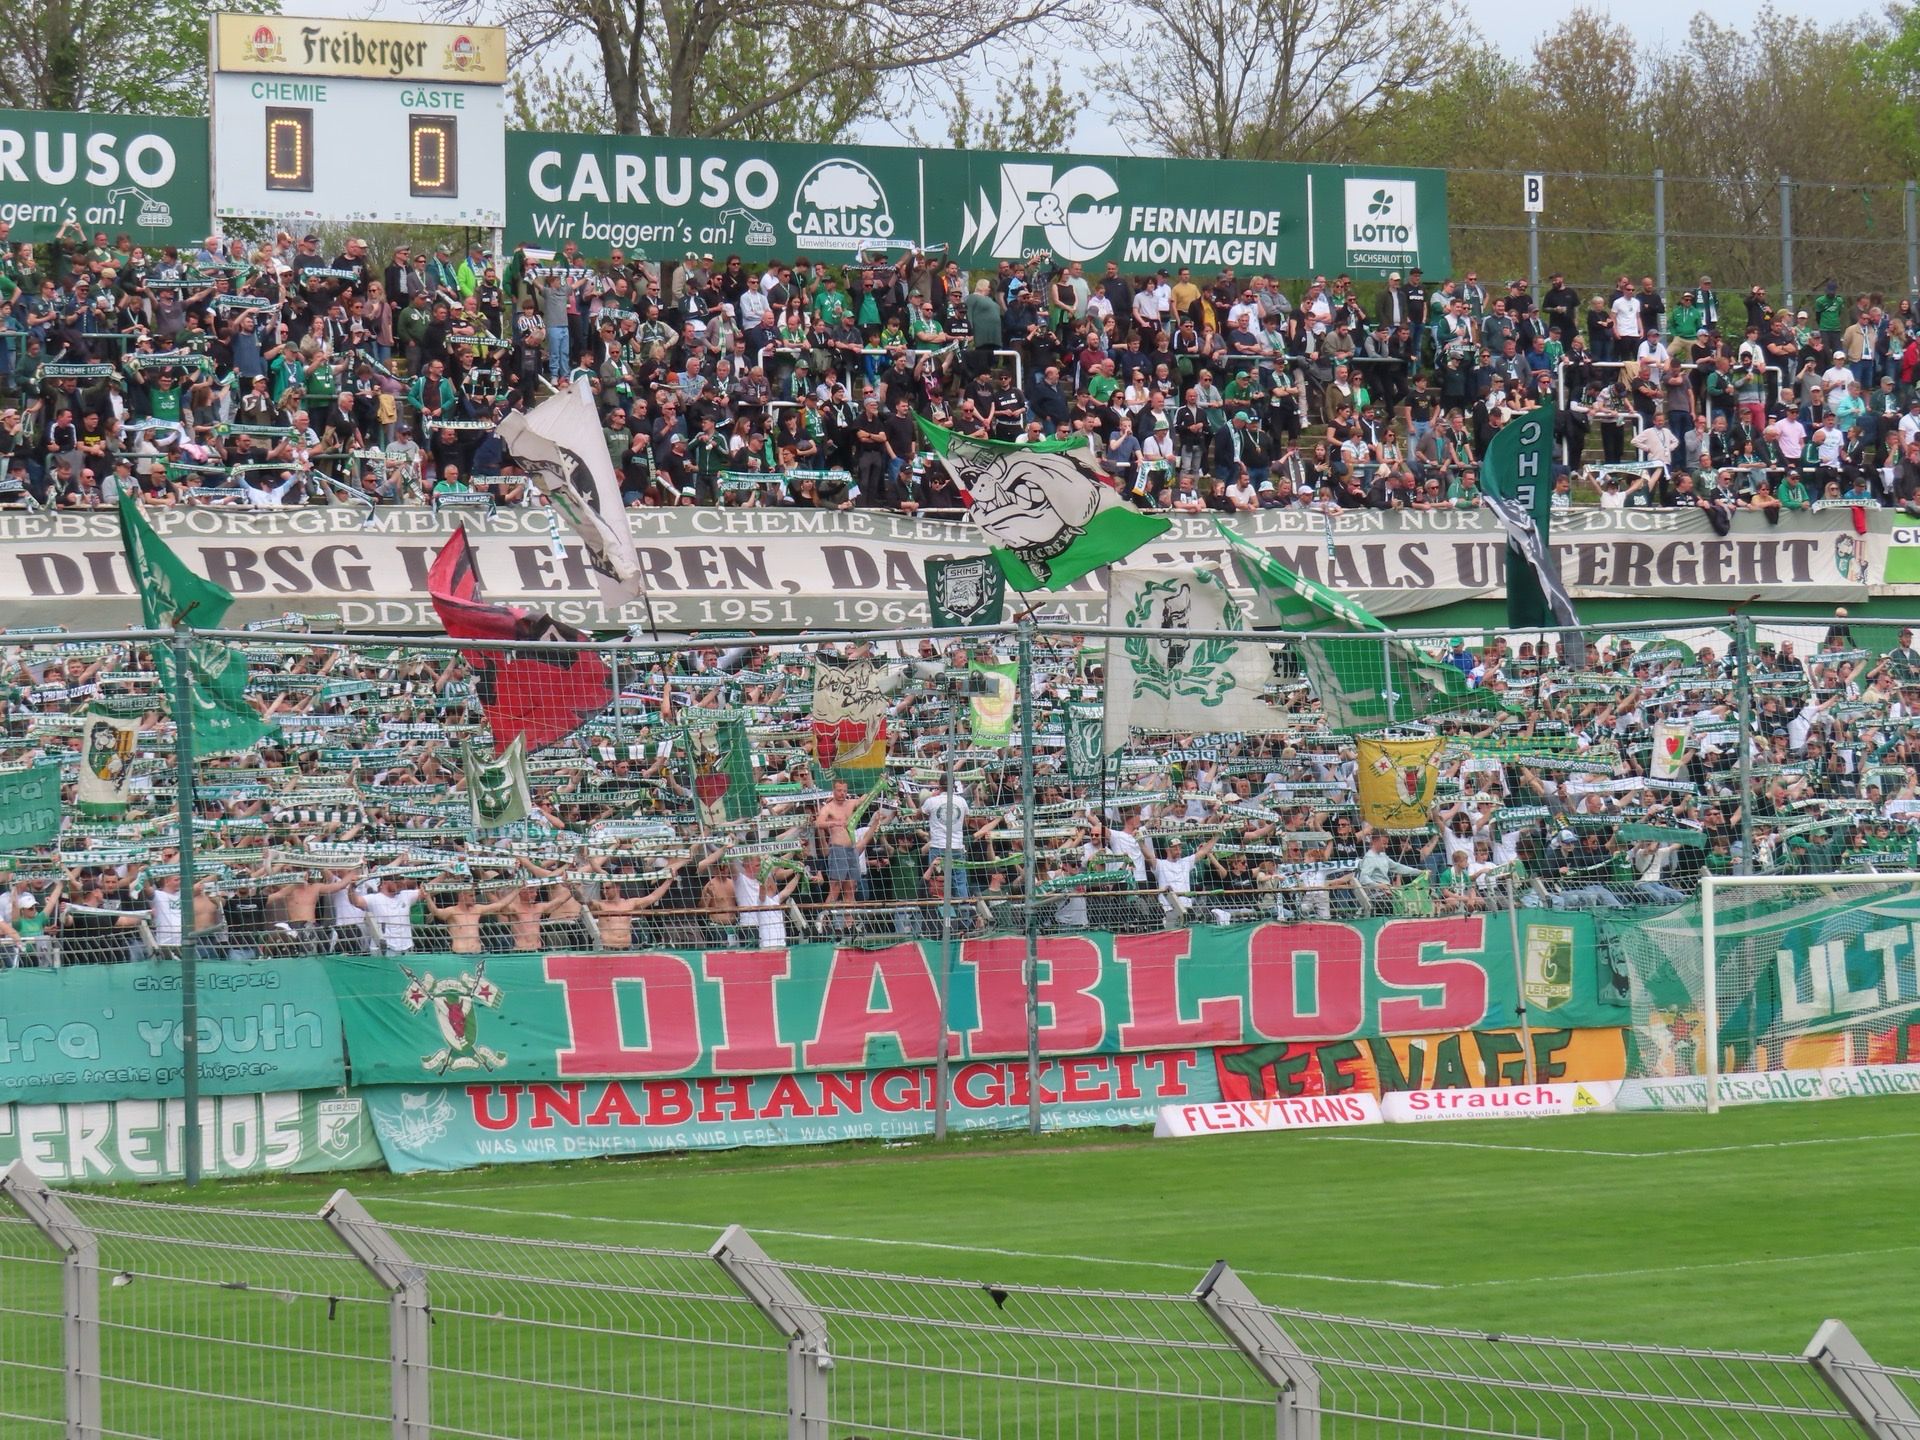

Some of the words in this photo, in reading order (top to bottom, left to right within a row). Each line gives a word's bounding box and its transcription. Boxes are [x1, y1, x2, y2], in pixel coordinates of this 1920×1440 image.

[301, 26, 428, 75] Freiberger
[251, 82, 327, 102] CHEMIE
[400, 87, 465, 109] GÄSTE
[270, 119, 302, 179] 0
[414, 127, 445, 188] 0
[528, 151, 779, 209] CARUSO
[1528, 178, 1540, 202] B
[85, 199, 125, 226] an!
[788, 210, 895, 237] CARUSO
[1129, 206, 1280, 238] FERNMELDE
[532, 212, 575, 238] Wir
[582, 211, 692, 249] baggern's
[700, 219, 735, 245] an!
[1352, 222, 1409, 244] LOTTO
[1124, 236, 1279, 267] MONTAGEN
[1352, 251, 1413, 264] SACHSENLOTTO
[304, 266, 354, 279] CHEMIE
[450, 336, 477, 345] CHEMIE
[480, 337, 508, 348] LEIPZIG
[45, 366, 59, 376] BSG
[60, 366, 86, 376] CHEMIE
[87, 365, 113, 375] LEIPZIG
[691, 510, 875, 537] CHEMIE
[1253, 510, 1384, 536] LEBEN
[1400, 507, 1481, 532] NUR
[1583, 508, 1678, 532] DICH
[198, 545, 374, 597] BSG
[950, 567, 979, 578] SKINS
[700, 599, 813, 627] 1951,
[387, 730, 446, 741] CHEMIE
[560, 793, 575, 801] BSG
[577, 792, 607, 801] CHEMIE
[609, 791, 639, 801] LEIPZIG
[1498, 806, 1550, 820] CHEMIE
[1848, 856, 1879, 865] CHEMIE
[1880, 852, 1907, 862] LEIPZIG
[1537, 929, 1562, 940] BSG
[542, 916, 1489, 1077] DIABLOS
[1527, 985, 1568, 996] LEIPZIG
[321, 1101, 358, 1113] LEIPZIG
[1409, 1087, 1562, 1110] Strauch.
[1279, 1097, 1366, 1124] TRANS
[1415, 1113, 1433, 1121] Die
[1437, 1112, 1463, 1120] Auto
[1466, 1111, 1500, 1119] GmbH
[476, 1138, 518, 1156] WAS
[522, 1137, 558, 1153] WIR
[648, 1133, 688, 1149] WAS
[693, 1129, 727, 1146] WIR
[800, 1125, 837, 1141] WAS
[843, 1122, 873, 1140] WIR
[880, 1119, 936, 1137] FÜHLE
[1066, 1108, 1101, 1123] BSG
